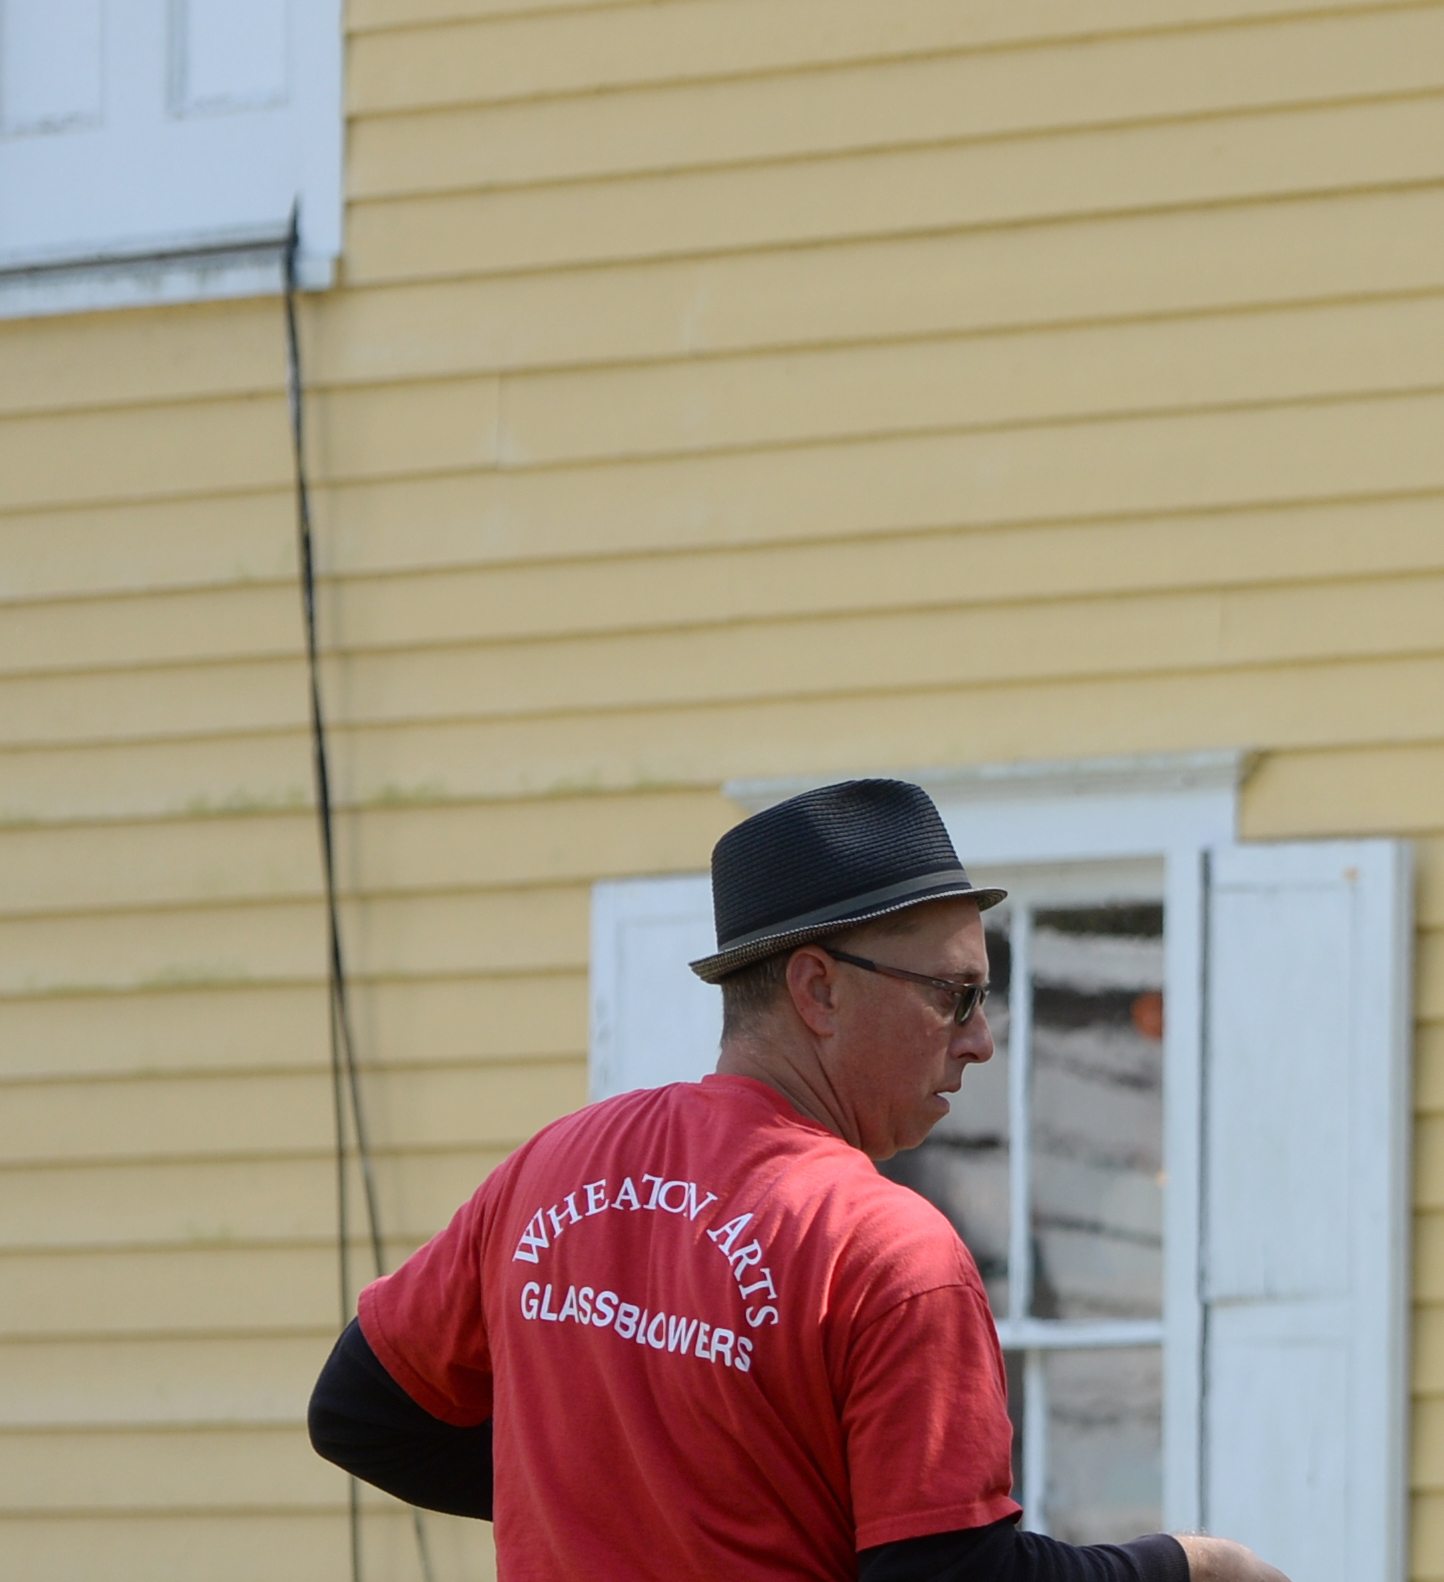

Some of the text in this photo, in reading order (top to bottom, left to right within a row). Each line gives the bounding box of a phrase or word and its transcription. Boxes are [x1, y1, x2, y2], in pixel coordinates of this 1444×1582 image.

[511, 1173, 779, 1327] WHEATON ARTS
[520, 1281, 754, 1373] GLASSBLOWERS
